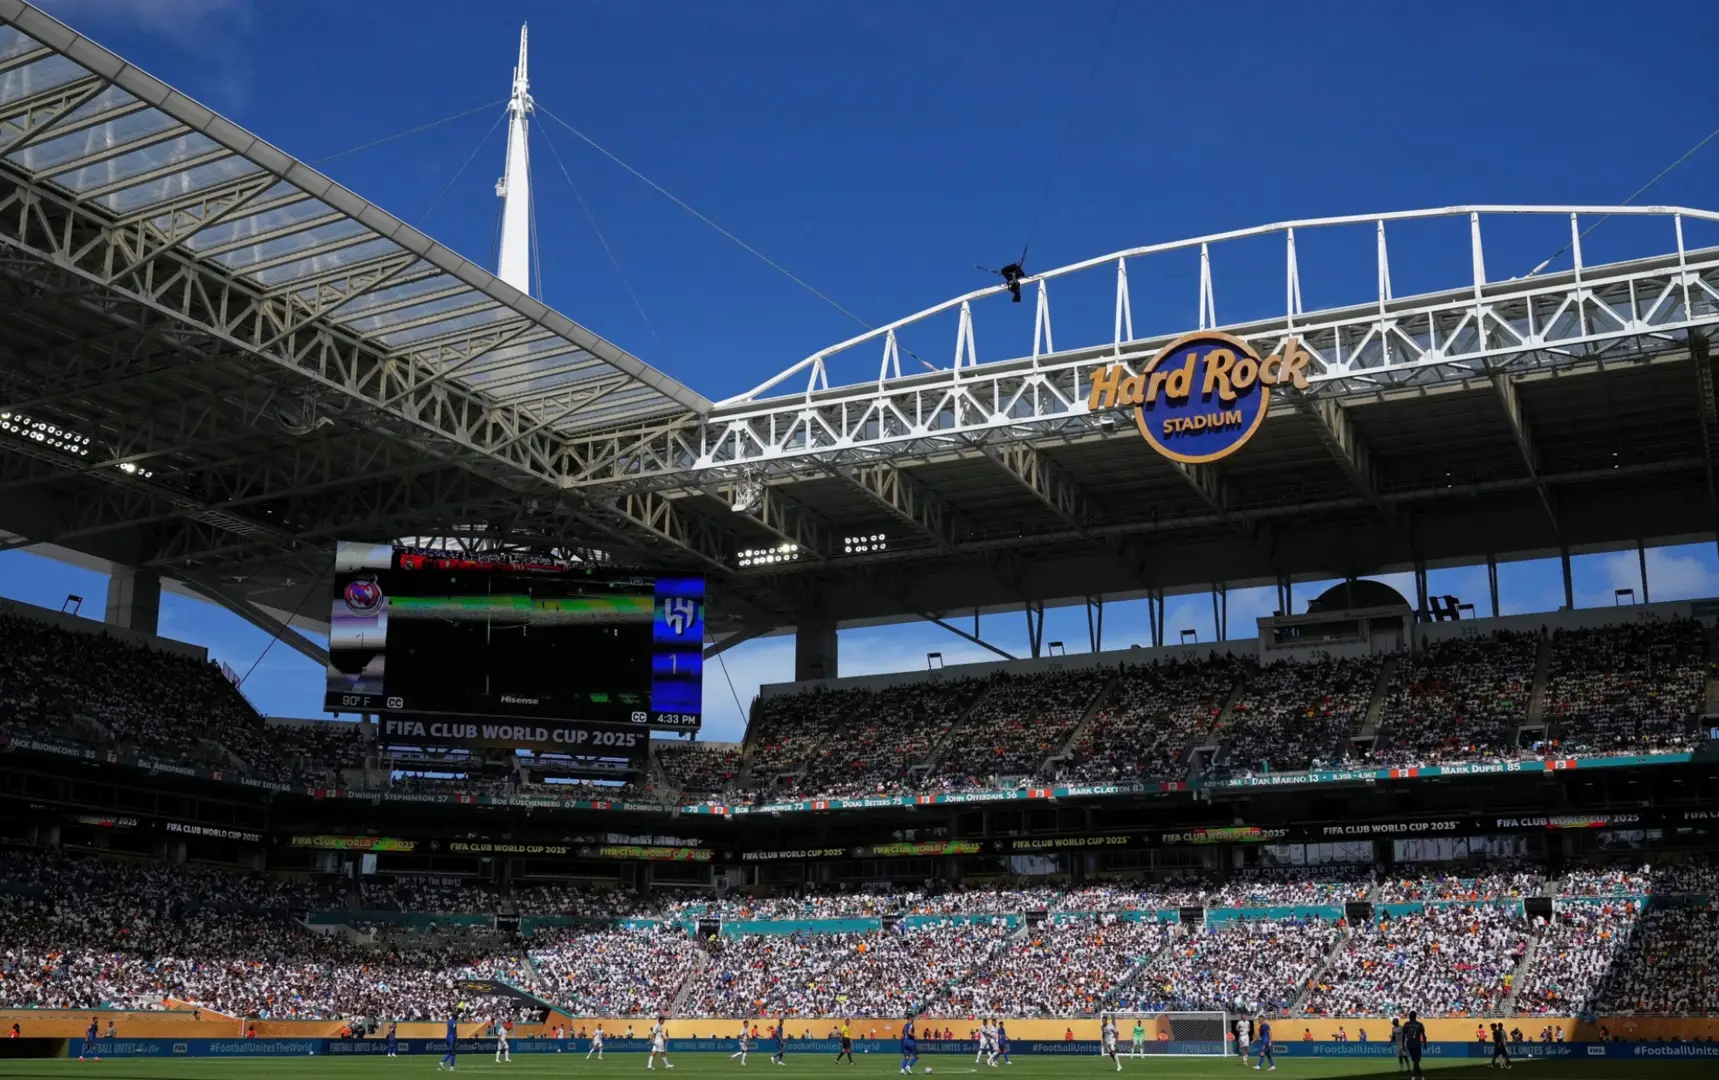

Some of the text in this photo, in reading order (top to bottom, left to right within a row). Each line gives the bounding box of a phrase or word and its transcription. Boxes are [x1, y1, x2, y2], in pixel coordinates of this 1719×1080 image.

[1088, 338, 1310, 411] Hard Rock
[1163, 410, 1242, 434] STADIUM
[669, 654, 677, 674] 1
[388, 698, 402, 708] CC
[501, 695, 539, 705] Hisense
[632, 713, 646, 722] CC
[657, 713, 696, 724] 4:33 PM
[386, 720, 427, 737] FIFA
[430, 722, 478, 738] CLUB
[482, 725, 548, 743] WORLD
[552, 729, 588, 745] CUP
[85, 750, 97, 759] 85
[1441, 763, 1521, 775] MARK DUPER 85
[1252, 777, 1270, 786] DAN
[1273, 775, 1306, 785] MARINO
[1308, 774, 1319, 783] 13
[1068, 784, 1144, 796] MARK CLAYTON 83
[348, 790, 448, 803] DWIGHT STEPHENSON 57
[944, 791, 1017, 803] JOHN OFFERDAHL 56
[565, 801, 576, 809] 67
[624, 803, 662, 812] RICHMOND
[688, 805, 699, 813] 78
[842, 800, 863, 808] DOUG
[893, 797, 902, 805] 75
[735, 805, 748, 814] BOB
[794, 803, 804, 811] 73
[1684, 811, 1704, 820] FIFA
[1497, 818, 1518, 828] FIFA
[1520, 817, 1546, 826] CLUB
[1549, 816, 1586, 825] WORLD
[166, 823, 182, 832] FIFA
[183, 824, 201, 835] CLUB
[202, 826, 226, 838] WORLD
[228, 830, 242, 840] CUP
[1323, 826, 1344, 835] FIFA
[1345, 825, 1370, 834] CLUB
[1372, 823, 1406, 833] WORLD
[1409, 822, 1428, 832] CUP
[292, 837, 312, 845] FIFA
[1162, 834, 1181, 842] FIFA
[1183, 832, 1205, 841] CLUB
[450, 843, 469, 851] FIFA
[471, 843, 492, 852] CLUB
[494, 844, 525, 853] WORLD
[526, 845, 543, 853] CUP
[1012, 840, 1030, 849] FIFA
[1032, 839, 1053, 848] CLUB
[1055, 838, 1085, 847] WORLD
[1086, 837, 1103, 846] CUP
[742, 852, 759, 860] FIFA
[760, 851, 778, 860] CLUB
[779, 850, 806, 859] WORLD
[807, 850, 822, 858] CUP
[873, 846, 890, 854] FIFA
[209, 1042, 313, 1052] #FootballUnitesTheWorld
[1520, 1046, 1543, 1056] UNITES
